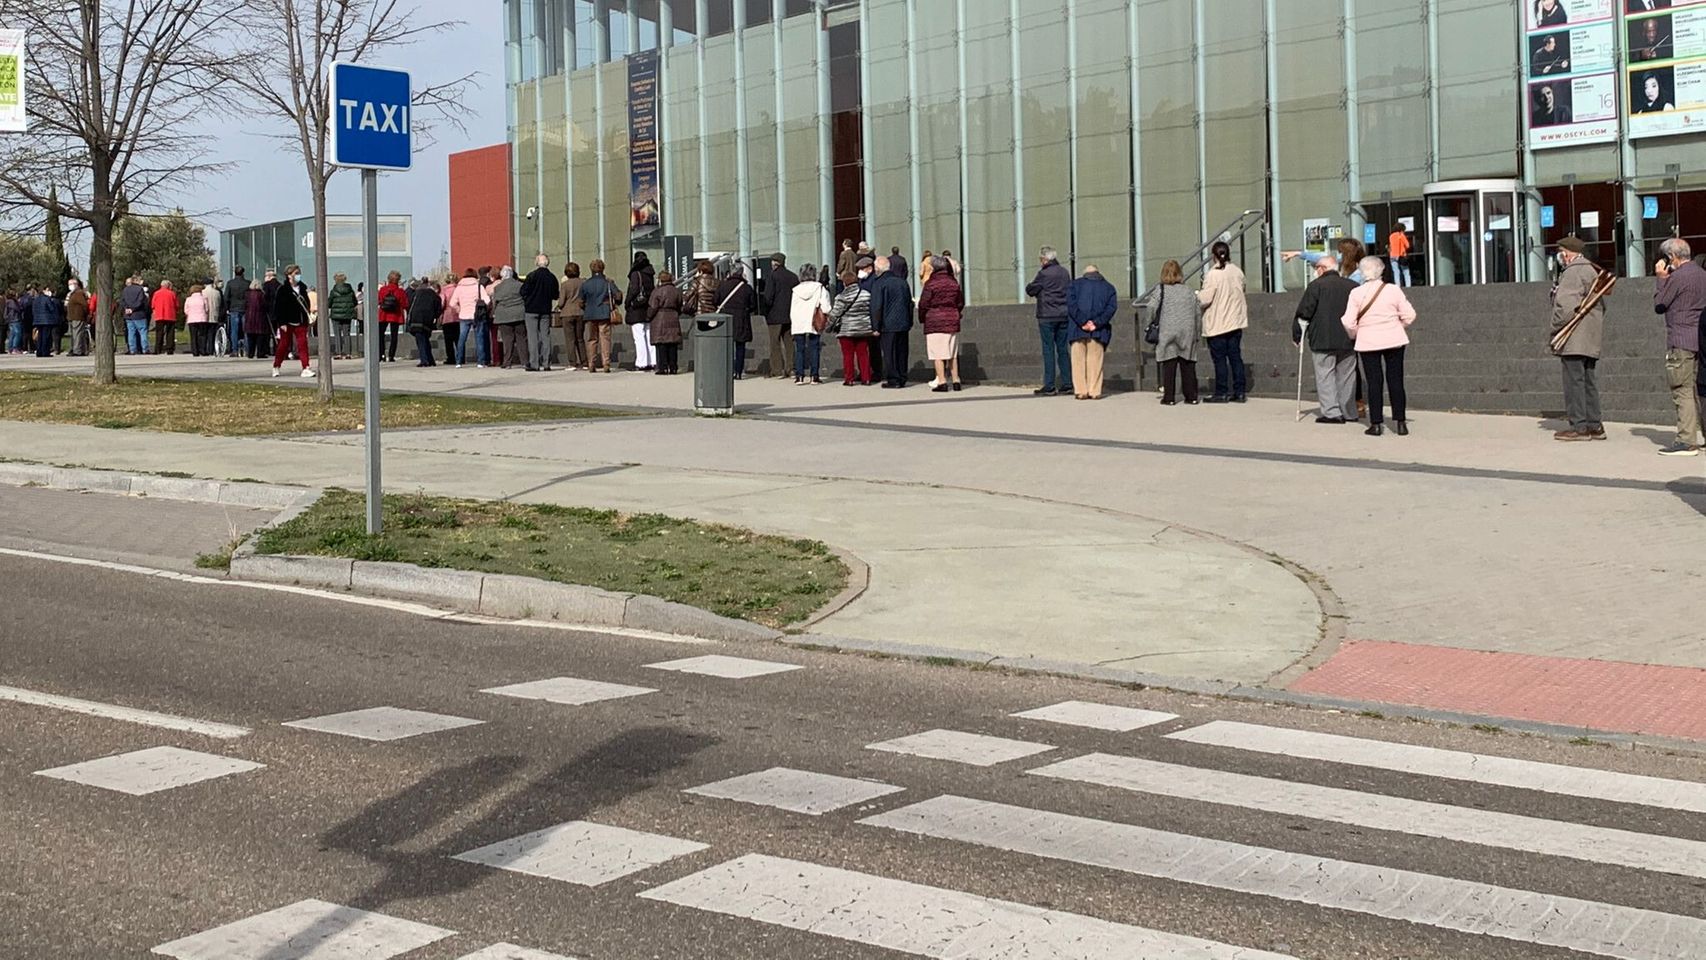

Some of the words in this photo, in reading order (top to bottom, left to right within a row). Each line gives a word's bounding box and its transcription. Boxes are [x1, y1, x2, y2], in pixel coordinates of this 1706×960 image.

[1599, 93, 1614, 109] 16
[339, 99, 408, 134] TAXI
[1540, 129, 1607, 141] WWW.OSCYL.COM
